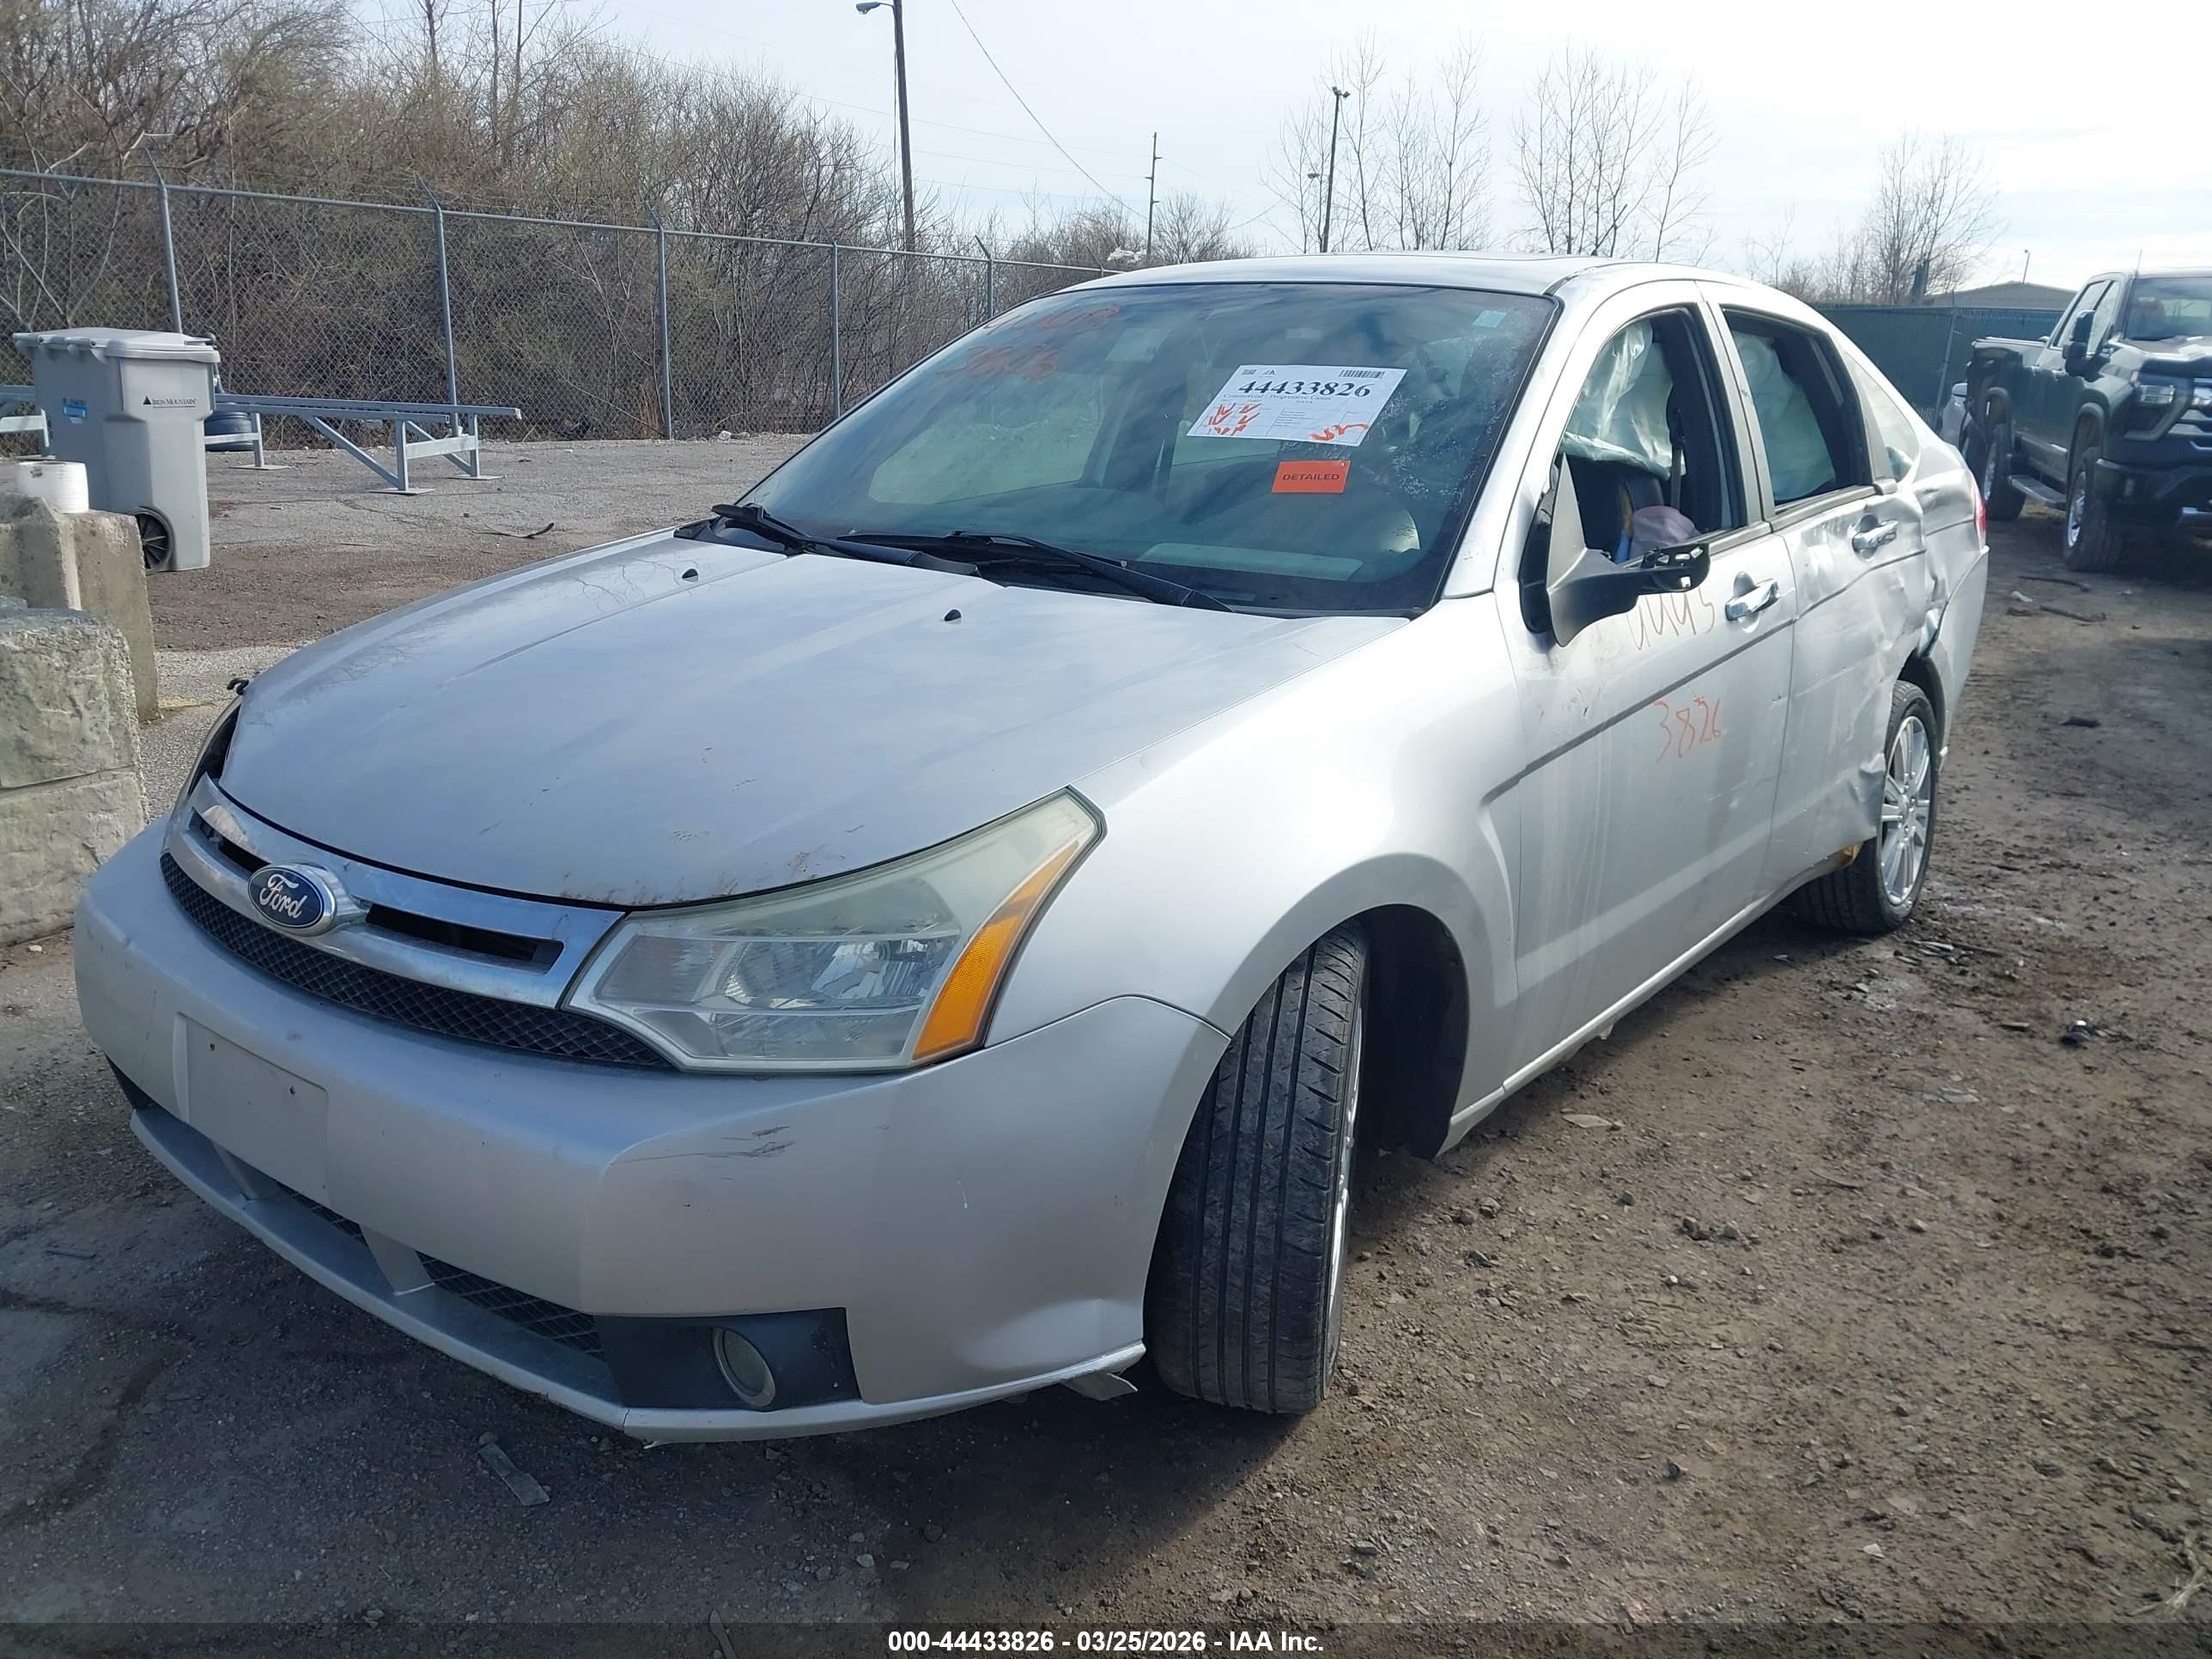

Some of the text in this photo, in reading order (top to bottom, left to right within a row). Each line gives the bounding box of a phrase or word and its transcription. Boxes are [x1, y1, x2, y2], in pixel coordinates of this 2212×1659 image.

[1238, 380, 1374, 397] 44433826
[1653, 697, 1722, 763] 3826
[259, 873, 308, 919] Ford
